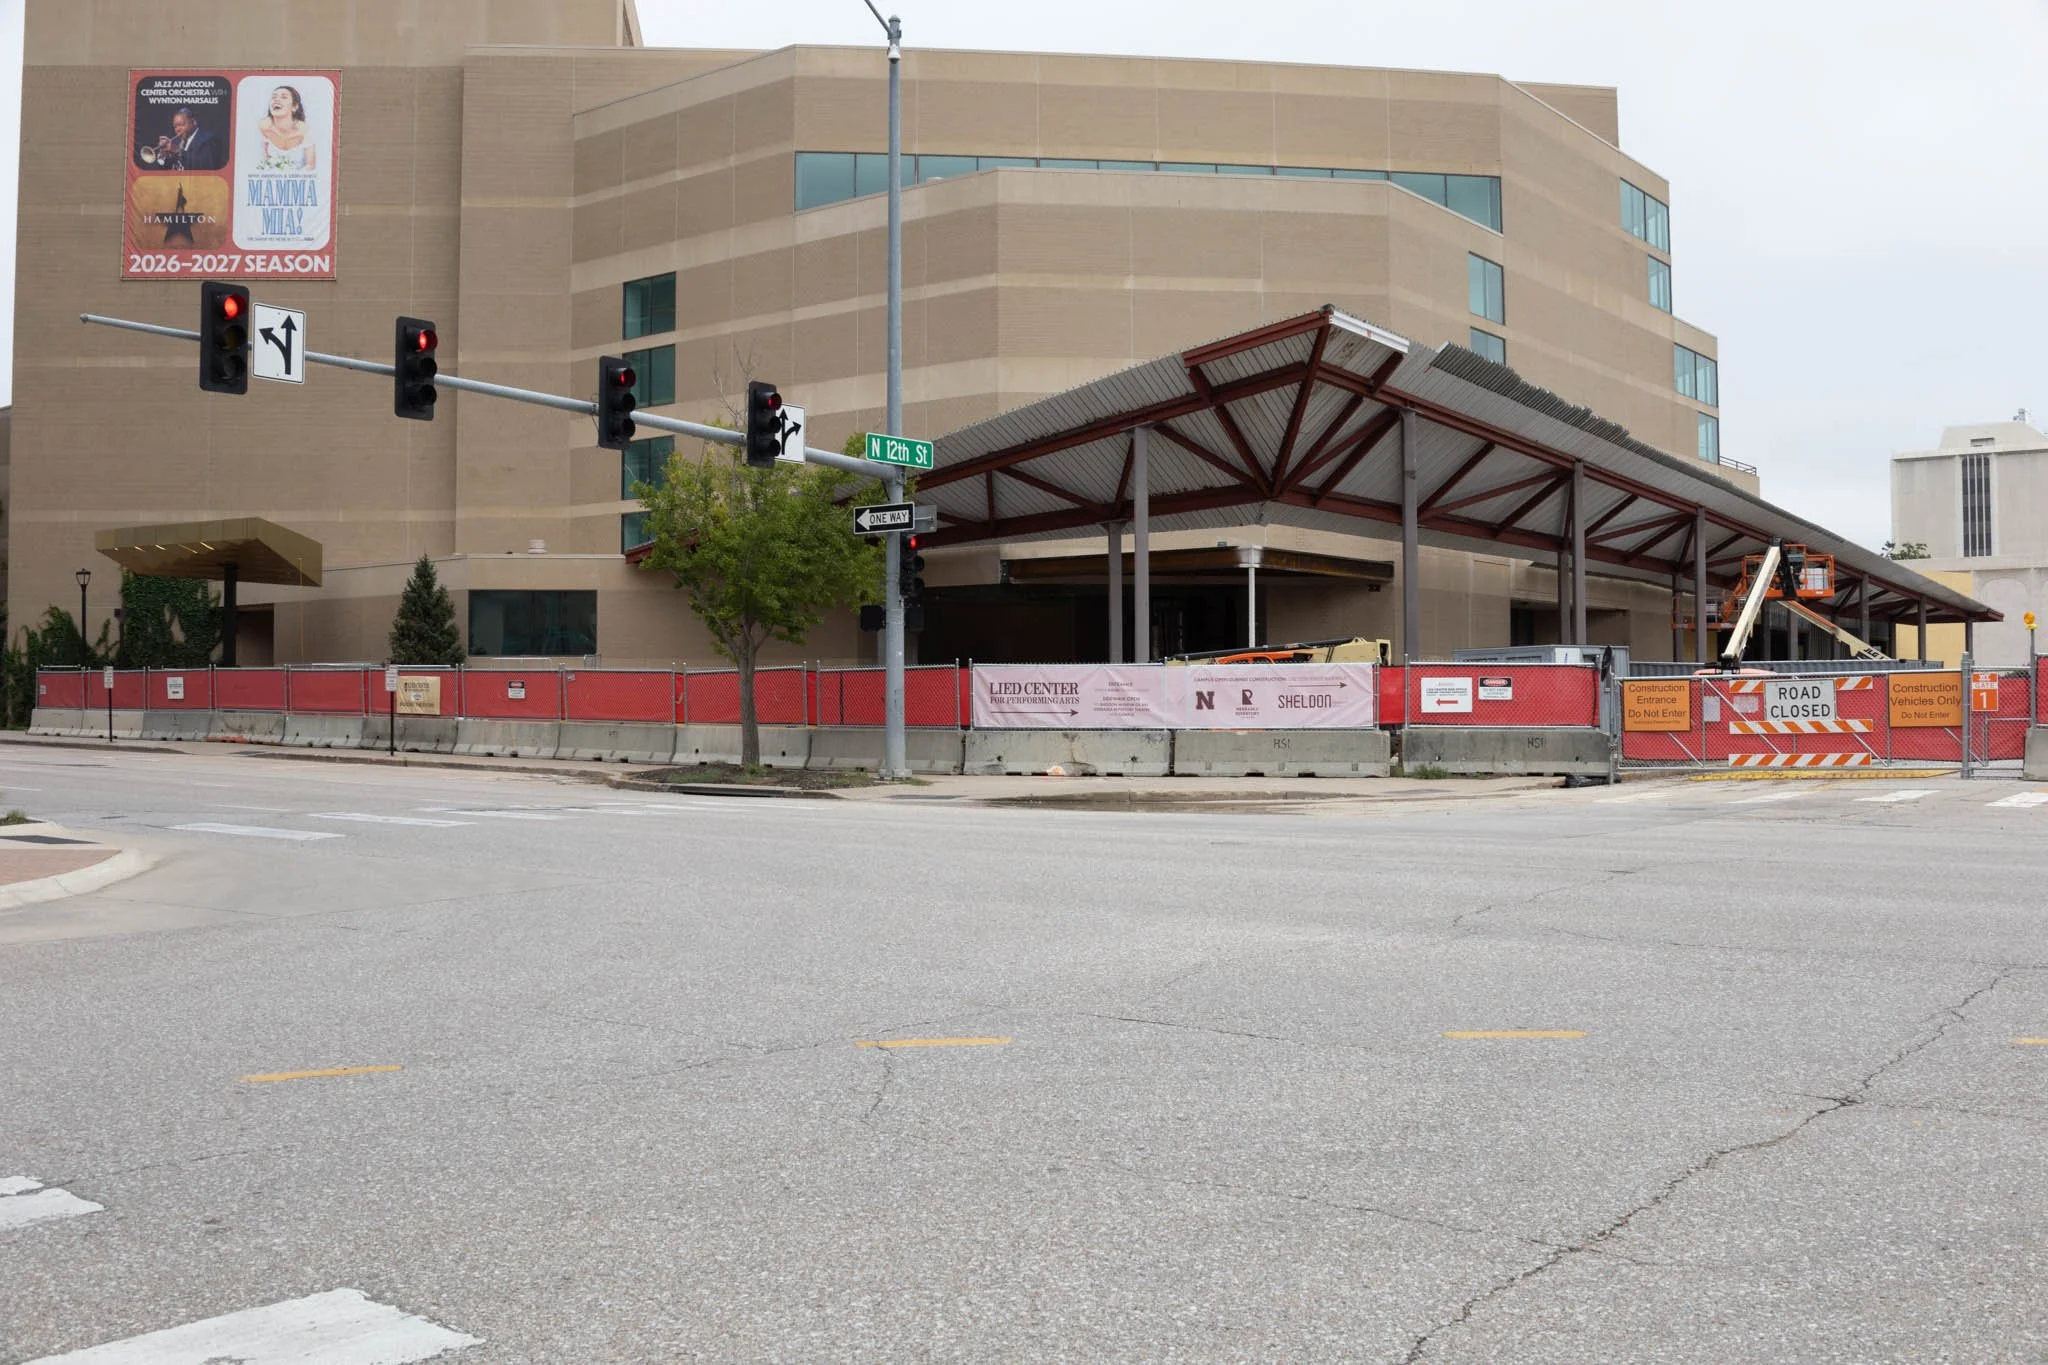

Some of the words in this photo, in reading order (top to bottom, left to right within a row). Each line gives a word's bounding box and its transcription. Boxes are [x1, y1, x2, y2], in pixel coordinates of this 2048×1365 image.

[153, 80, 172, 88] JAZZ
[172, 80, 182, 88] AT
[182, 80, 215, 88] LINCOLN
[140, 88, 167, 96] CENTER
[168, 88, 210, 96] ORCHESTRA
[247, 179, 318, 206] MAMMA
[143, 215, 216, 224] HAMILTON
[261, 207, 303, 235] MIA!
[244, 254, 330, 273] SEASON
[871, 437, 880, 458] N
[886, 439, 910, 463] 12th
[915, 444, 928, 465] St
[869, 511, 888, 525] ONE
[889, 510, 908, 522] WAY
[990, 682, 1022, 695] LIED
[1023, 682, 1079, 695] CENTER
[1628, 683, 1685, 693] Construction
[1778, 686, 1821, 700] ROAD
[1892, 683, 1959, 693] Construction
[1006, 697, 1059, 705] PERFORMING
[1060, 697, 1080, 705] ARTS
[1195, 690, 1215, 710] N
[1278, 694, 1332, 709] SHELDON
[1636, 695, 1677, 704] Entrance
[1890, 696, 1934, 706] Vehicles
[1937, 695, 1961, 708] Only
[1979, 691, 1987, 709] 1
[1628, 709, 1641, 718] Do
[1643, 709, 1659, 718] Not
[1661, 709, 1686, 718] Enter
[1770, 703, 1830, 718] CLOSED
[1914, 711, 1928, 719] Not
[1929, 711, 1950, 719] Enter
